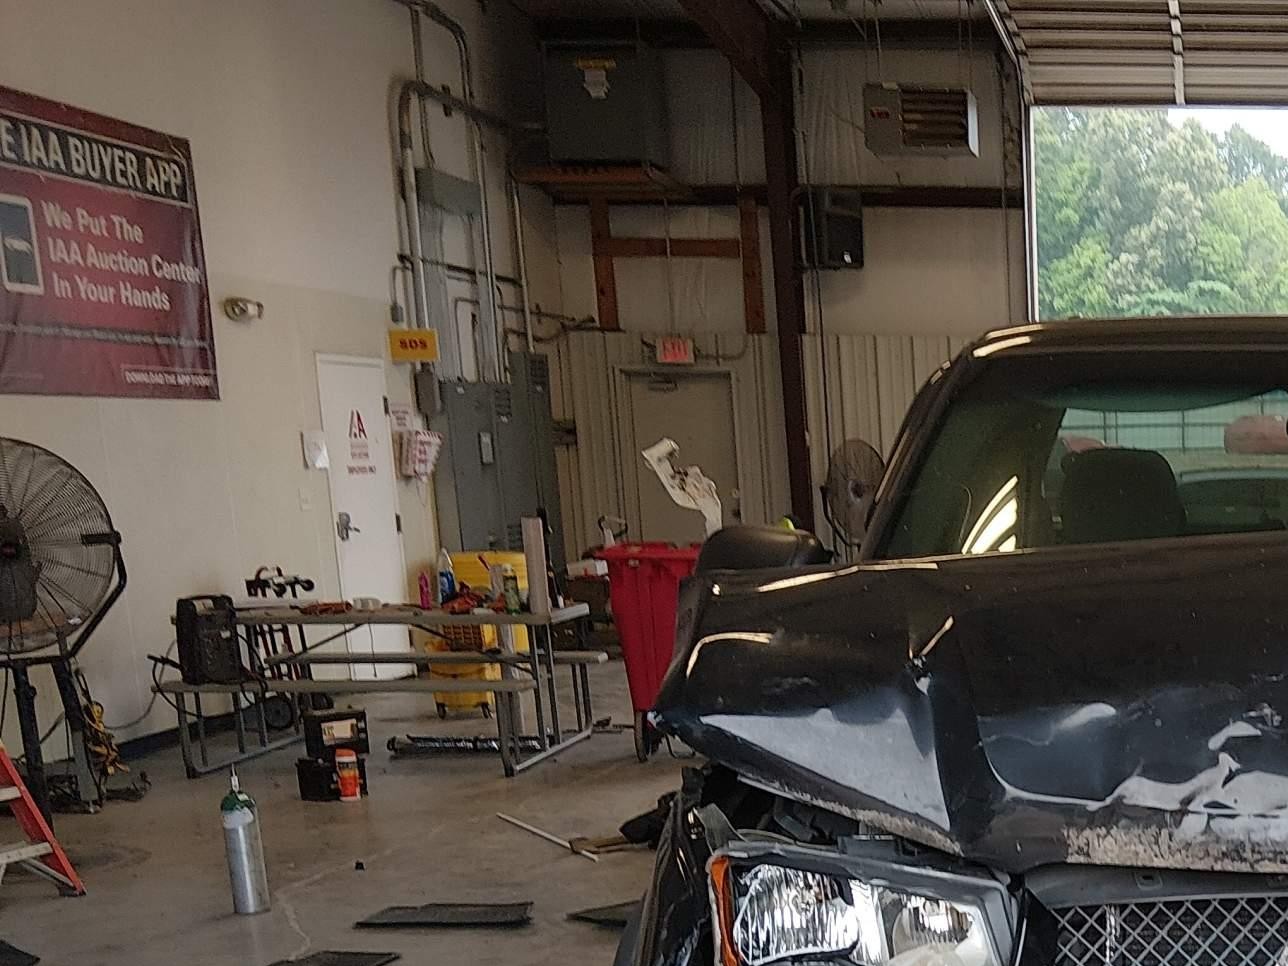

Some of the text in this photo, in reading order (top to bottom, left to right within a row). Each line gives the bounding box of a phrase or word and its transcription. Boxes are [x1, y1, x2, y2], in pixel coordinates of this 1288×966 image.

[20, 124, 66, 171] IAA
[68, 137, 142, 190] BUYER
[145, 157, 182, 197] APP
[41, 200, 144, 244] We Put The
[48, 238, 84, 267] IAA
[87, 242, 150, 277] Auction
[53, 271, 171, 311] In Your Hands
